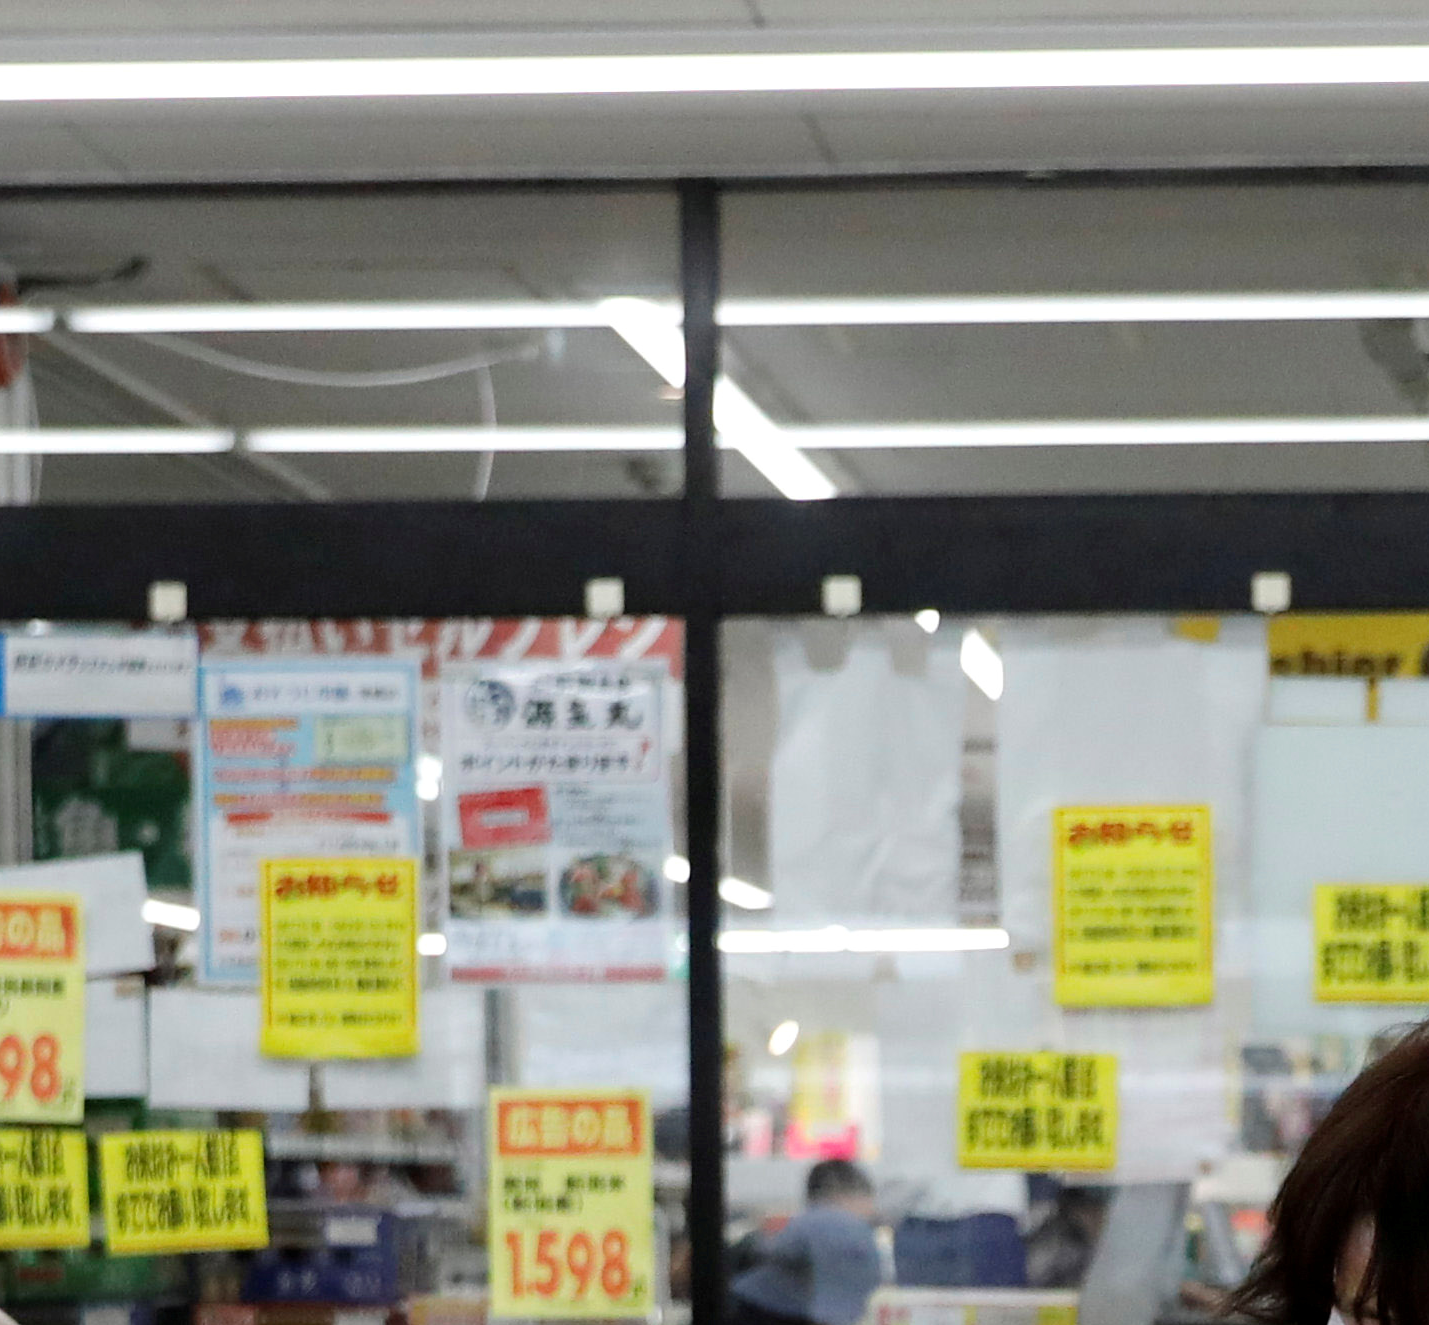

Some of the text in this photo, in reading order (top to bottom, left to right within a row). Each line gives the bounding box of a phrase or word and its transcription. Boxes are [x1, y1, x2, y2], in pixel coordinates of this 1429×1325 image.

[1269, 648, 1407, 679] shier
[507, 1105, 634, 1149] 広告の品
